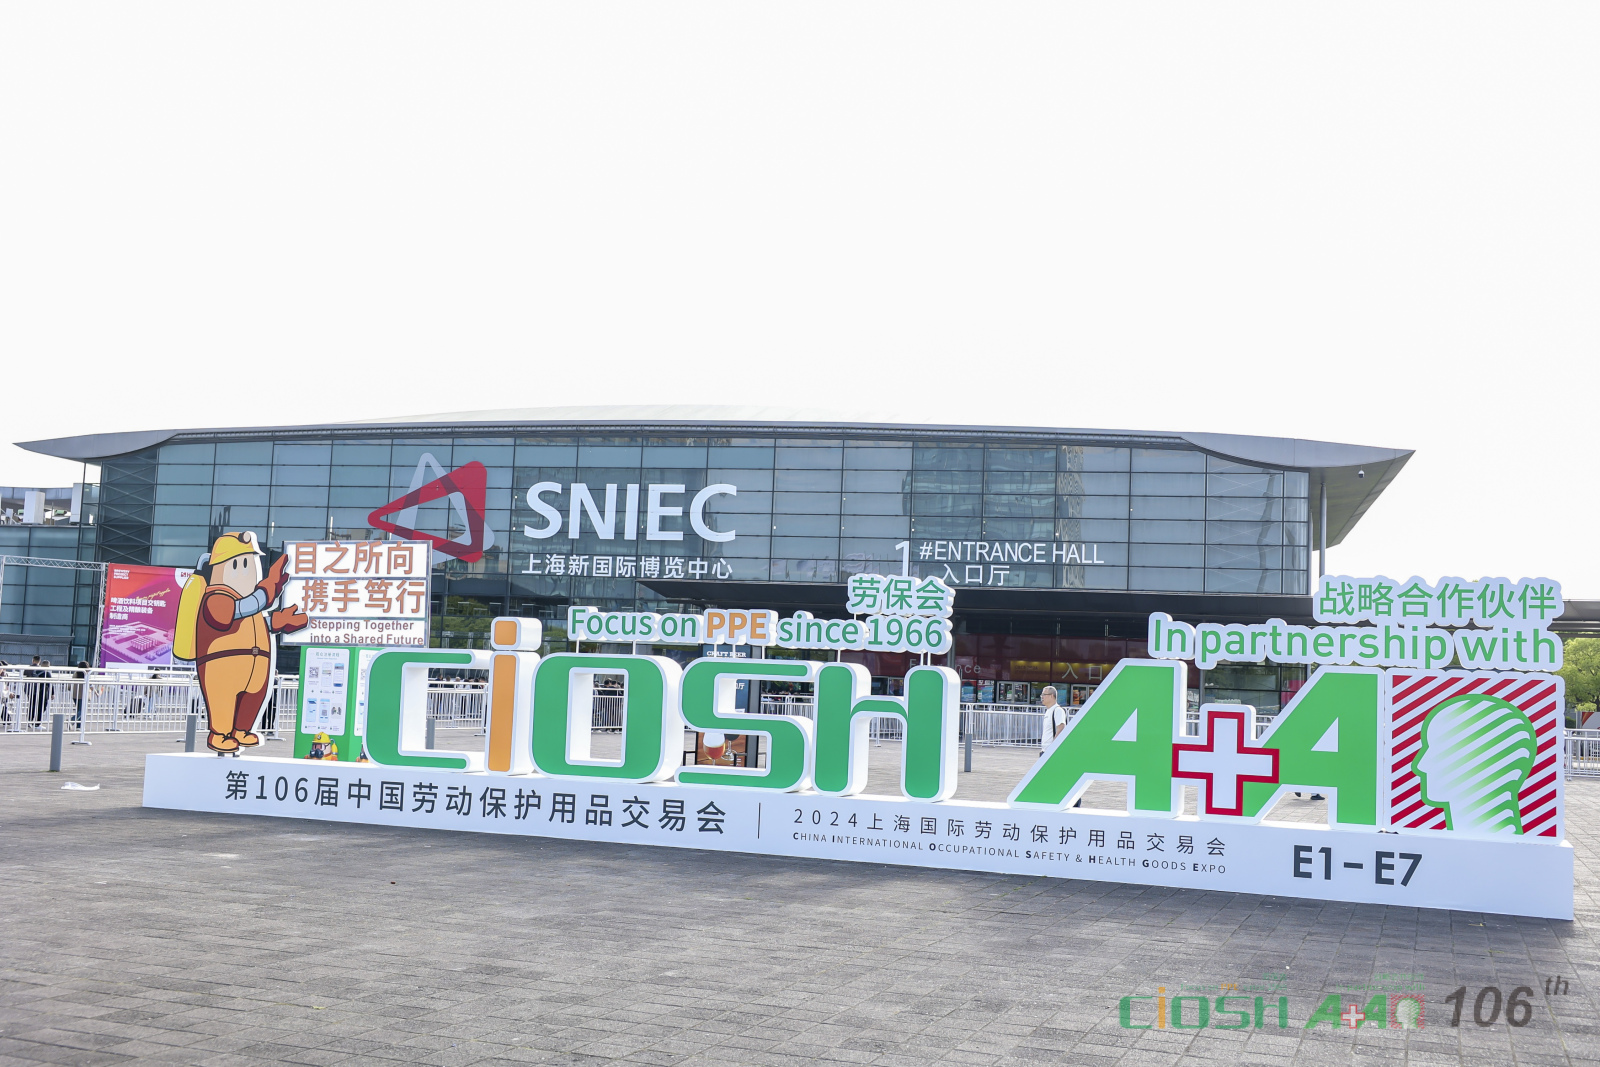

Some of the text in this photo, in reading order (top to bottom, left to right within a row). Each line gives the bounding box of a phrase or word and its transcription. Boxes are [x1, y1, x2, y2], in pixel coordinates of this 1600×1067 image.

[523, 481, 737, 542] SNIEC
[295, 541, 413, 575] 目之所向
[521, 553, 733, 580] 上海新国际博览中心
[895, 540, 1104, 577] 1 #ENTRANCE HALL
[941, 564, 1010, 586] 入口厅
[302, 579, 425, 614] 携手笃行
[851, 576, 946, 611] 劳保会
[1319, 581, 1557, 620] 战略合作伙伴
[310, 619, 414, 631] Stepping Together
[310, 633, 424, 645] into a Shared Future
[571, 608, 943, 648] Focus on PPE since 1966
[1154, 620, 1557, 669] In partnership with
[1061, 663, 1103, 680] 入口
[1013, 660, 1379, 827] A+A
[224, 770, 727, 835] 第106届中国劳动保护用品交易会
[794, 808, 1226, 856] 2024上海国际劳动保护用品交易会
[792, 832, 1226, 874] CHINA INTERNATIONAL OCCUPATIONAL SAFETY & HEALTH GOODS EXPO
